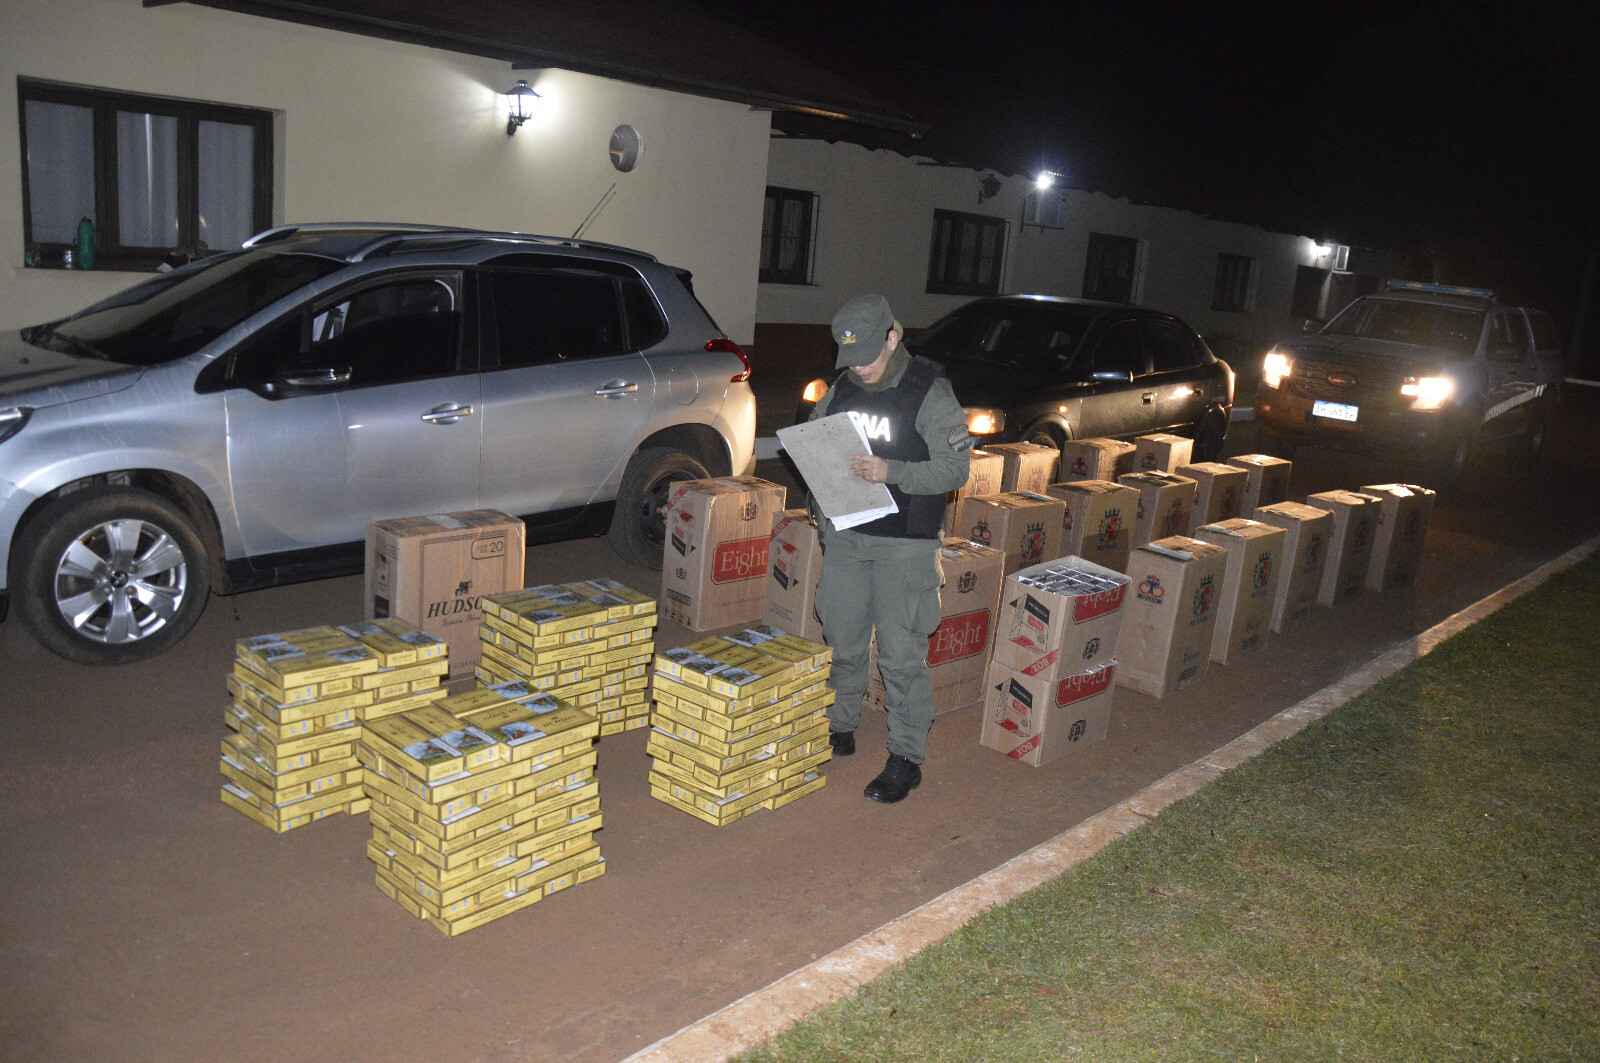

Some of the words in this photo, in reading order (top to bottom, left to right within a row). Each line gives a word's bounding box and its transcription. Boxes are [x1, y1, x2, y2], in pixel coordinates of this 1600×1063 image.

[490, 540, 504, 553] 20
[720, 546, 768, 575] Eight
[426, 595, 485, 618] HUDSO
[934, 622, 982, 656] Eight
[1031, 658, 1050, 673] BOX
[1016, 741, 1034, 756] BOX
